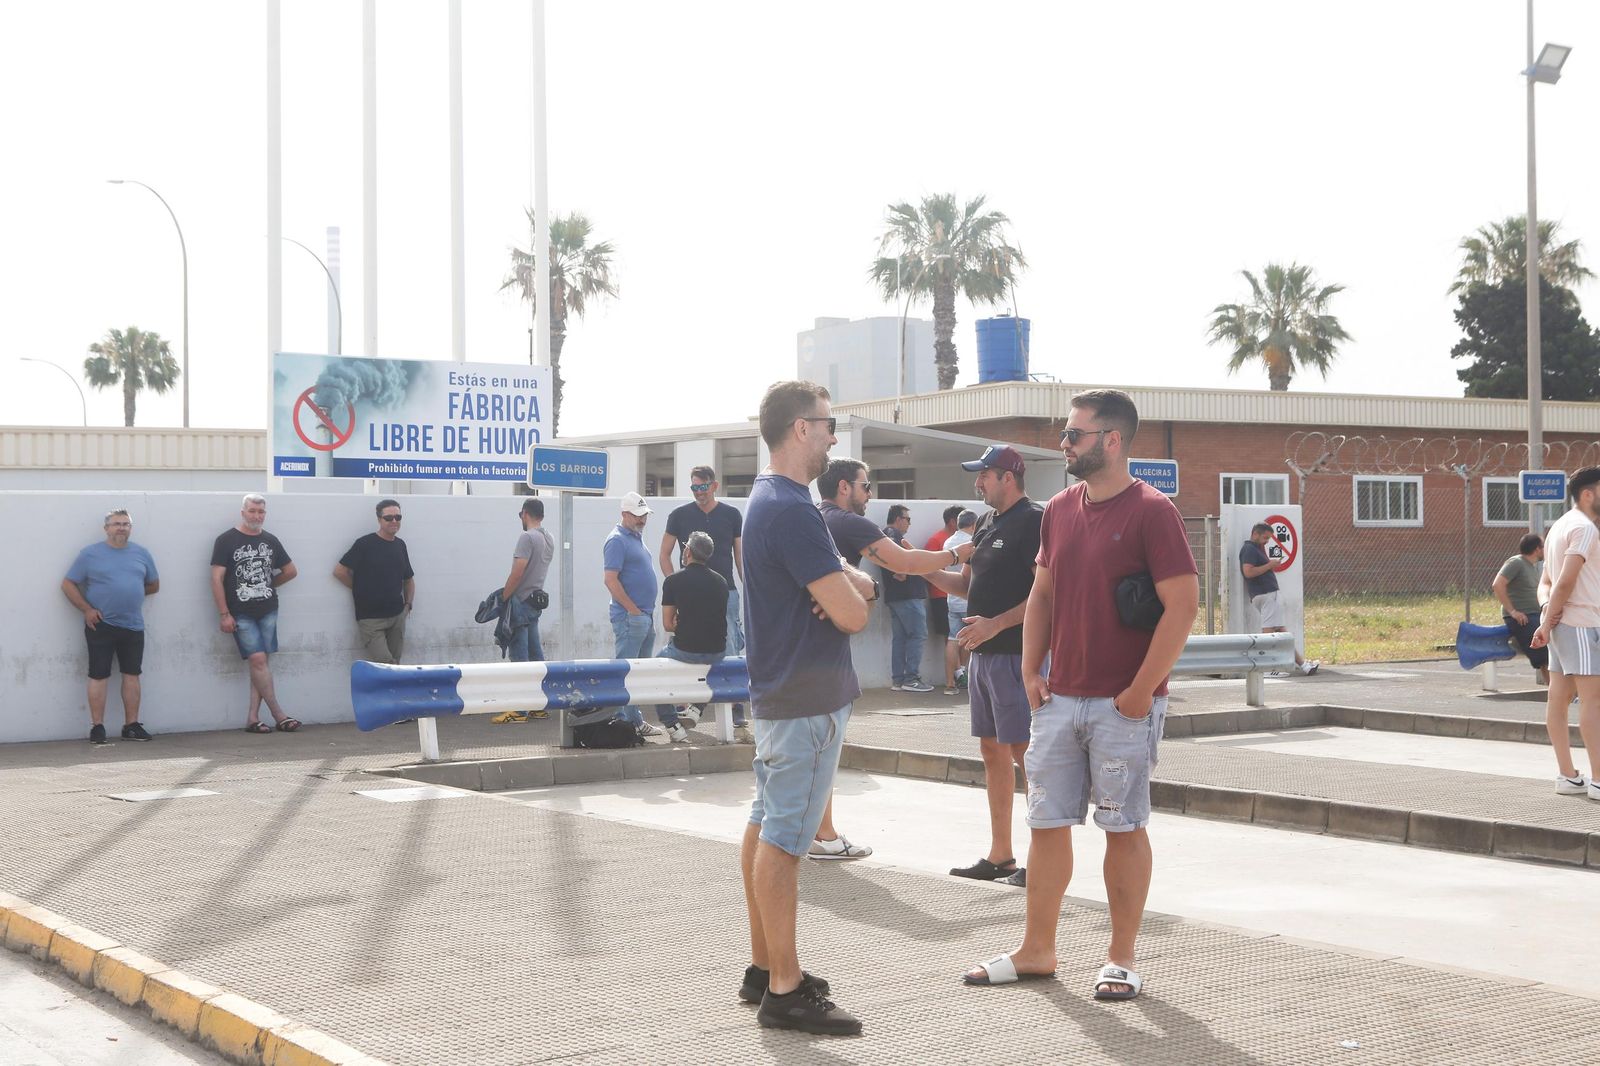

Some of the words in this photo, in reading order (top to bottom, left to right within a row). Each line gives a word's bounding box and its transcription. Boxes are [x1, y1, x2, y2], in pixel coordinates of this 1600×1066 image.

[449, 371, 486, 387] Estás
[491, 377, 508, 388] en
[513, 378, 538, 389] una
[448, 388, 541, 423] FÁBRICA
[369, 423, 434, 452] LIBRE
[443, 425, 470, 453] DE
[479, 427, 540, 455] HUMO
[280, 462, 310, 471] ACERINOX
[368, 462, 414, 473] Prohibido
[416, 464, 443, 474] fumar
[458, 465, 479, 475] toda
[481, 465, 490, 475] la
[535, 462, 556, 472] LOS
[560, 463, 604, 475] BARRIOS
[1134, 468, 1172, 477] ALGECIRAS
